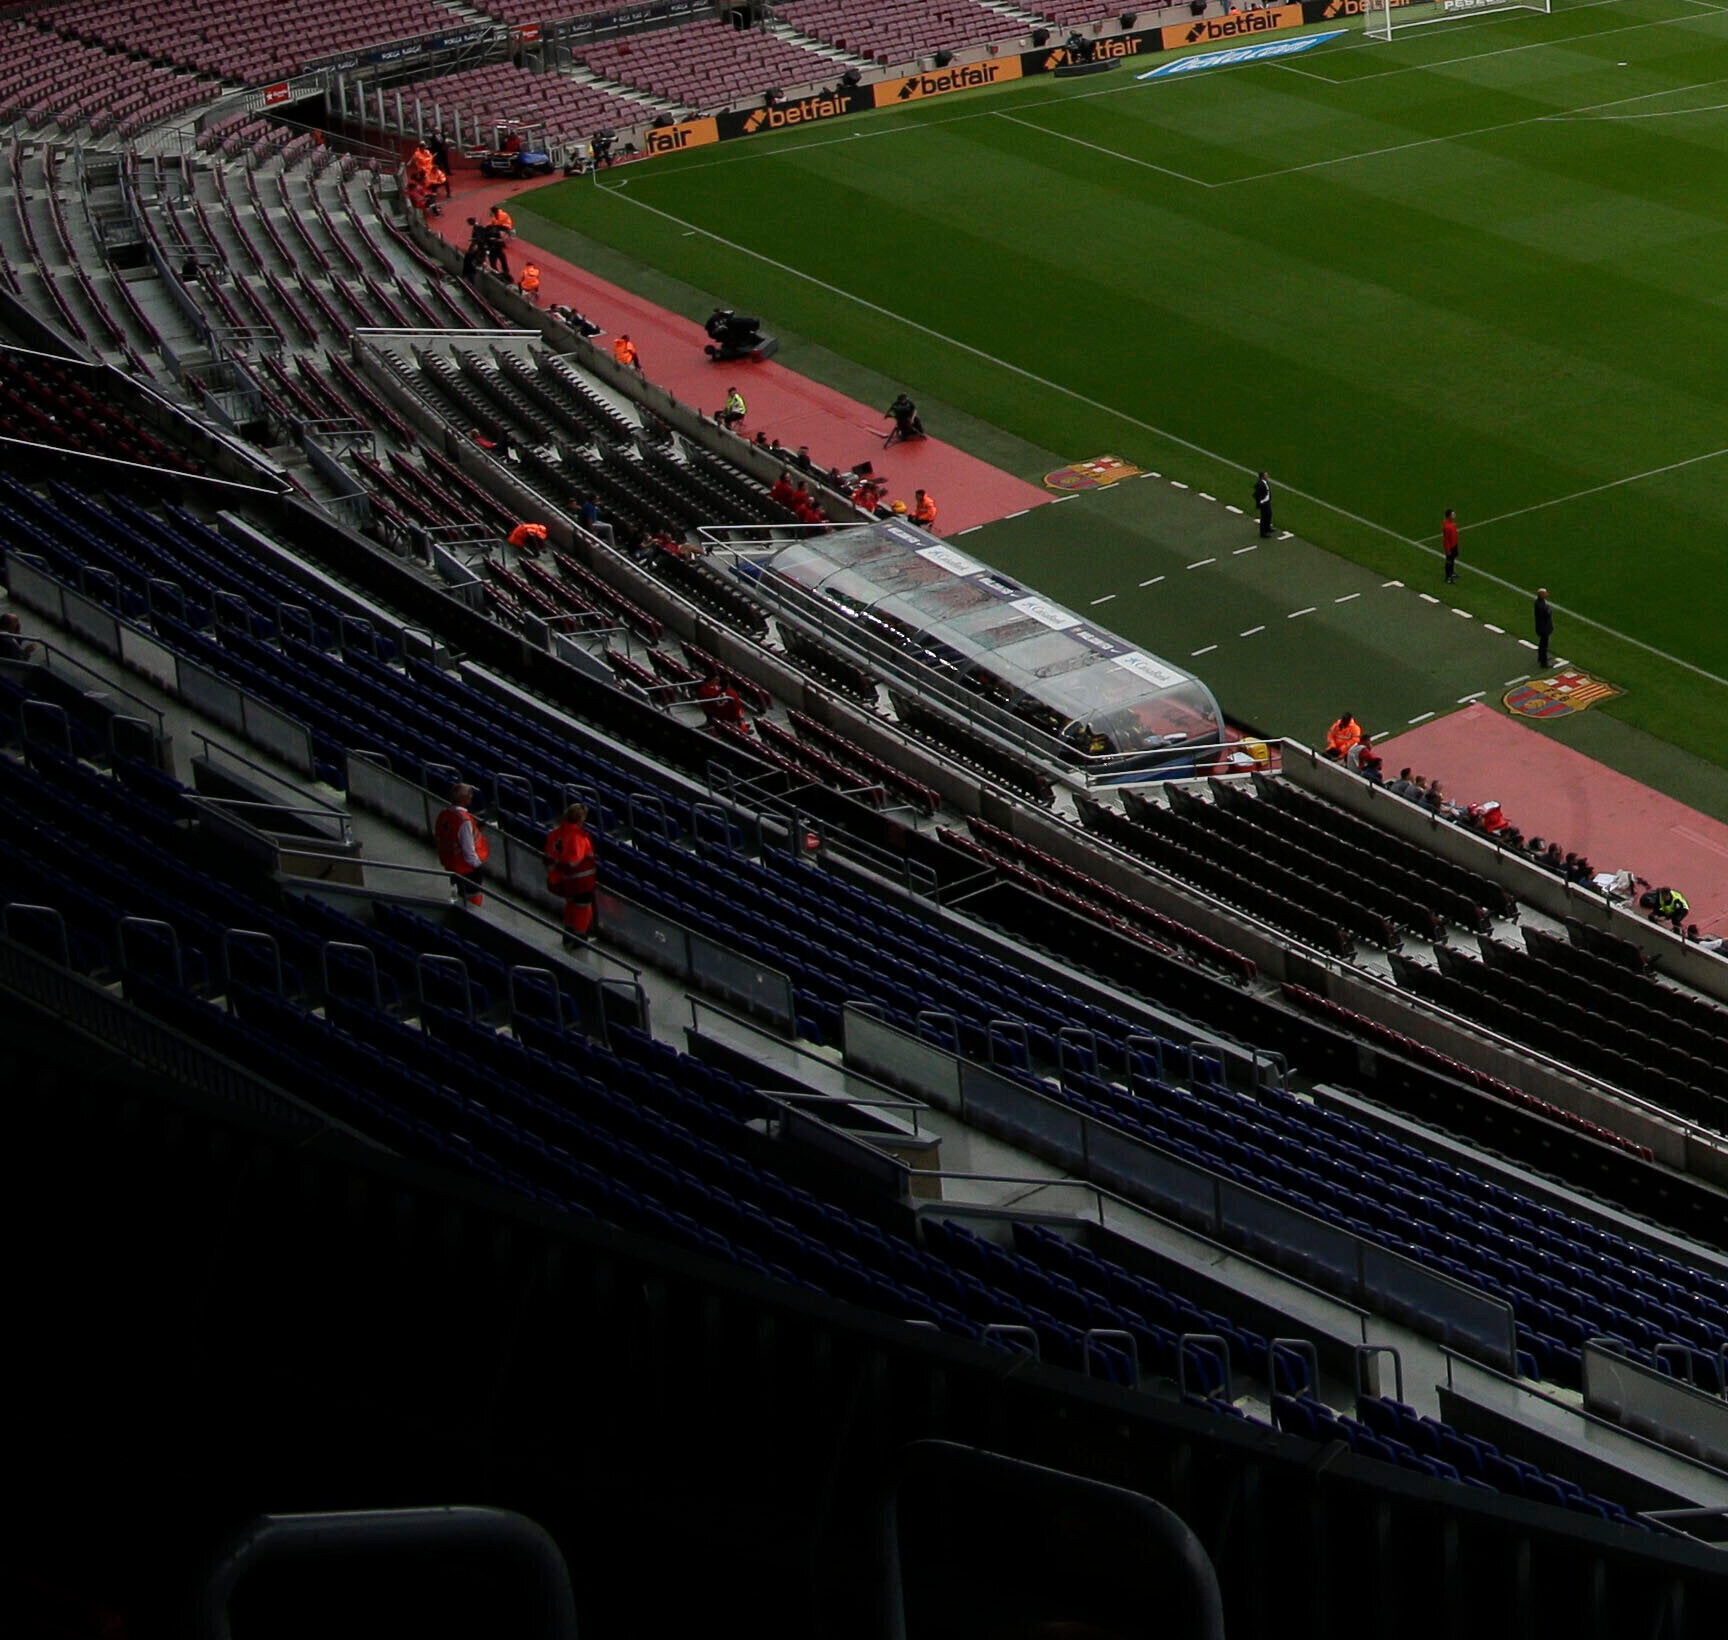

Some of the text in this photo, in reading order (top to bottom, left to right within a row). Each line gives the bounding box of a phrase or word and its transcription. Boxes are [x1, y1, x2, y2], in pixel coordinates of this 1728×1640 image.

[1208, 9, 1280, 38] betfair
[1066, 37, 1142, 64] tfair
[921, 65, 998, 94] betfair
[769, 95, 851, 126] betfair
